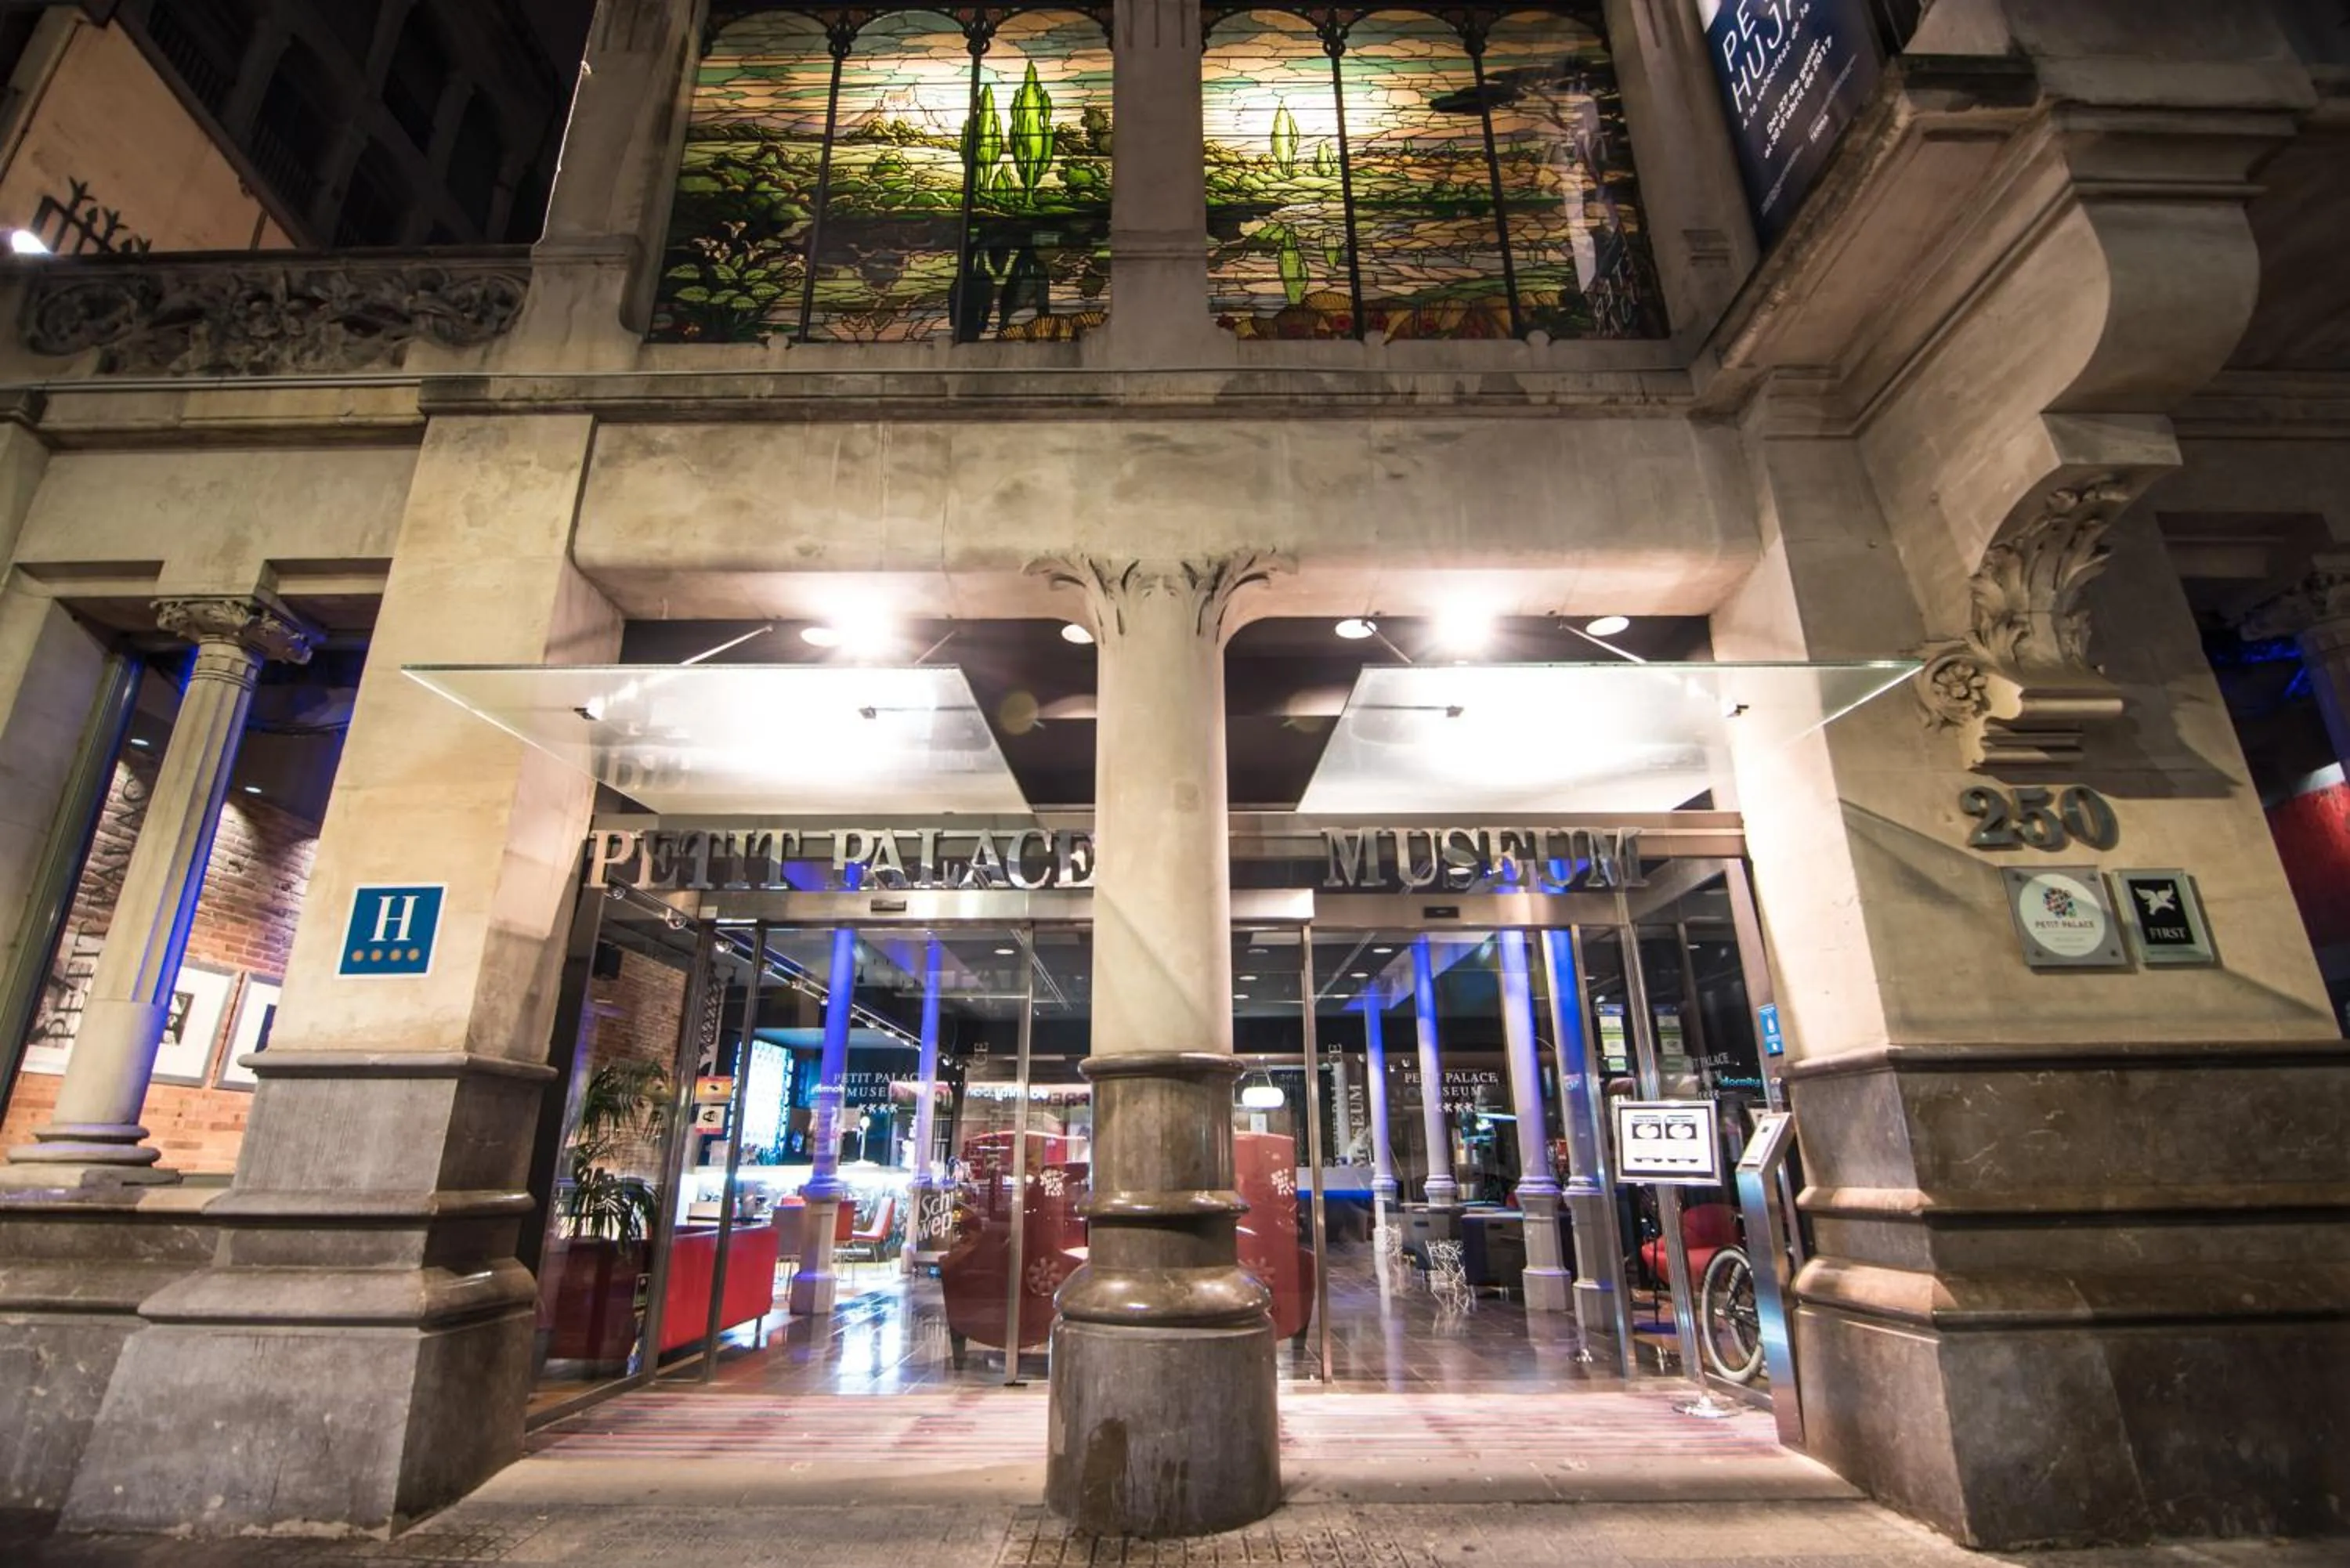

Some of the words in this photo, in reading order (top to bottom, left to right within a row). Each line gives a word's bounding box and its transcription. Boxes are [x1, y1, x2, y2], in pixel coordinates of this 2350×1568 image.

[1958, 784, 2120, 852] 250
[584, 828, 801, 891] PETIT
[830, 826, 1095, 891] PALACE
[1321, 826, 1650, 890] MUSEUM
[369, 895, 420, 941] H
[2034, 919, 2059, 929] PETIT
[2061, 919, 2095, 929] PALACE
[2149, 927, 2187, 940] FIRST
[833, 1072, 872, 1084] PETIT
[1445, 1072, 1497, 1084] PALACE
